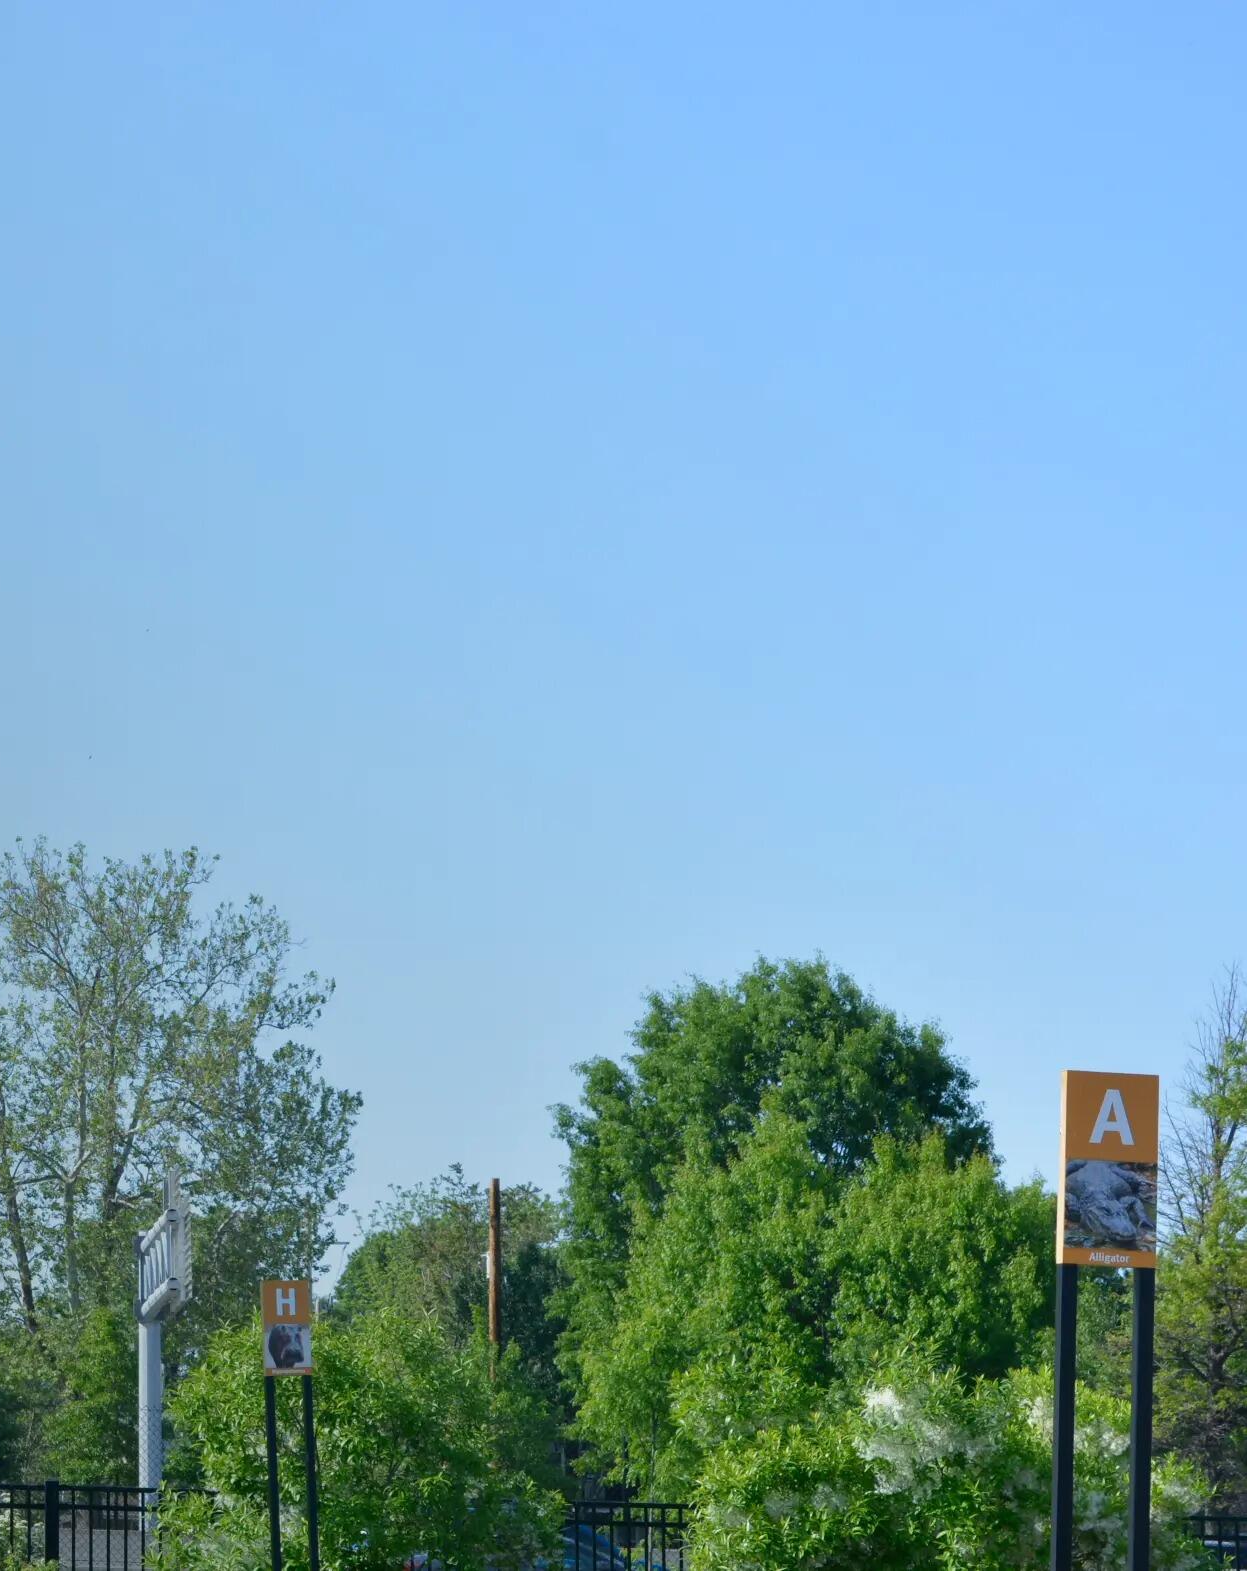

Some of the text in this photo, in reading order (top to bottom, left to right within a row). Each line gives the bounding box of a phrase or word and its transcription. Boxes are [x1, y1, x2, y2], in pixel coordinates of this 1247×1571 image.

[1089, 1088, 1135, 1146] A
[1089, 1252, 1130, 1264] Alligator
[275, 1288, 296, 1316] H
